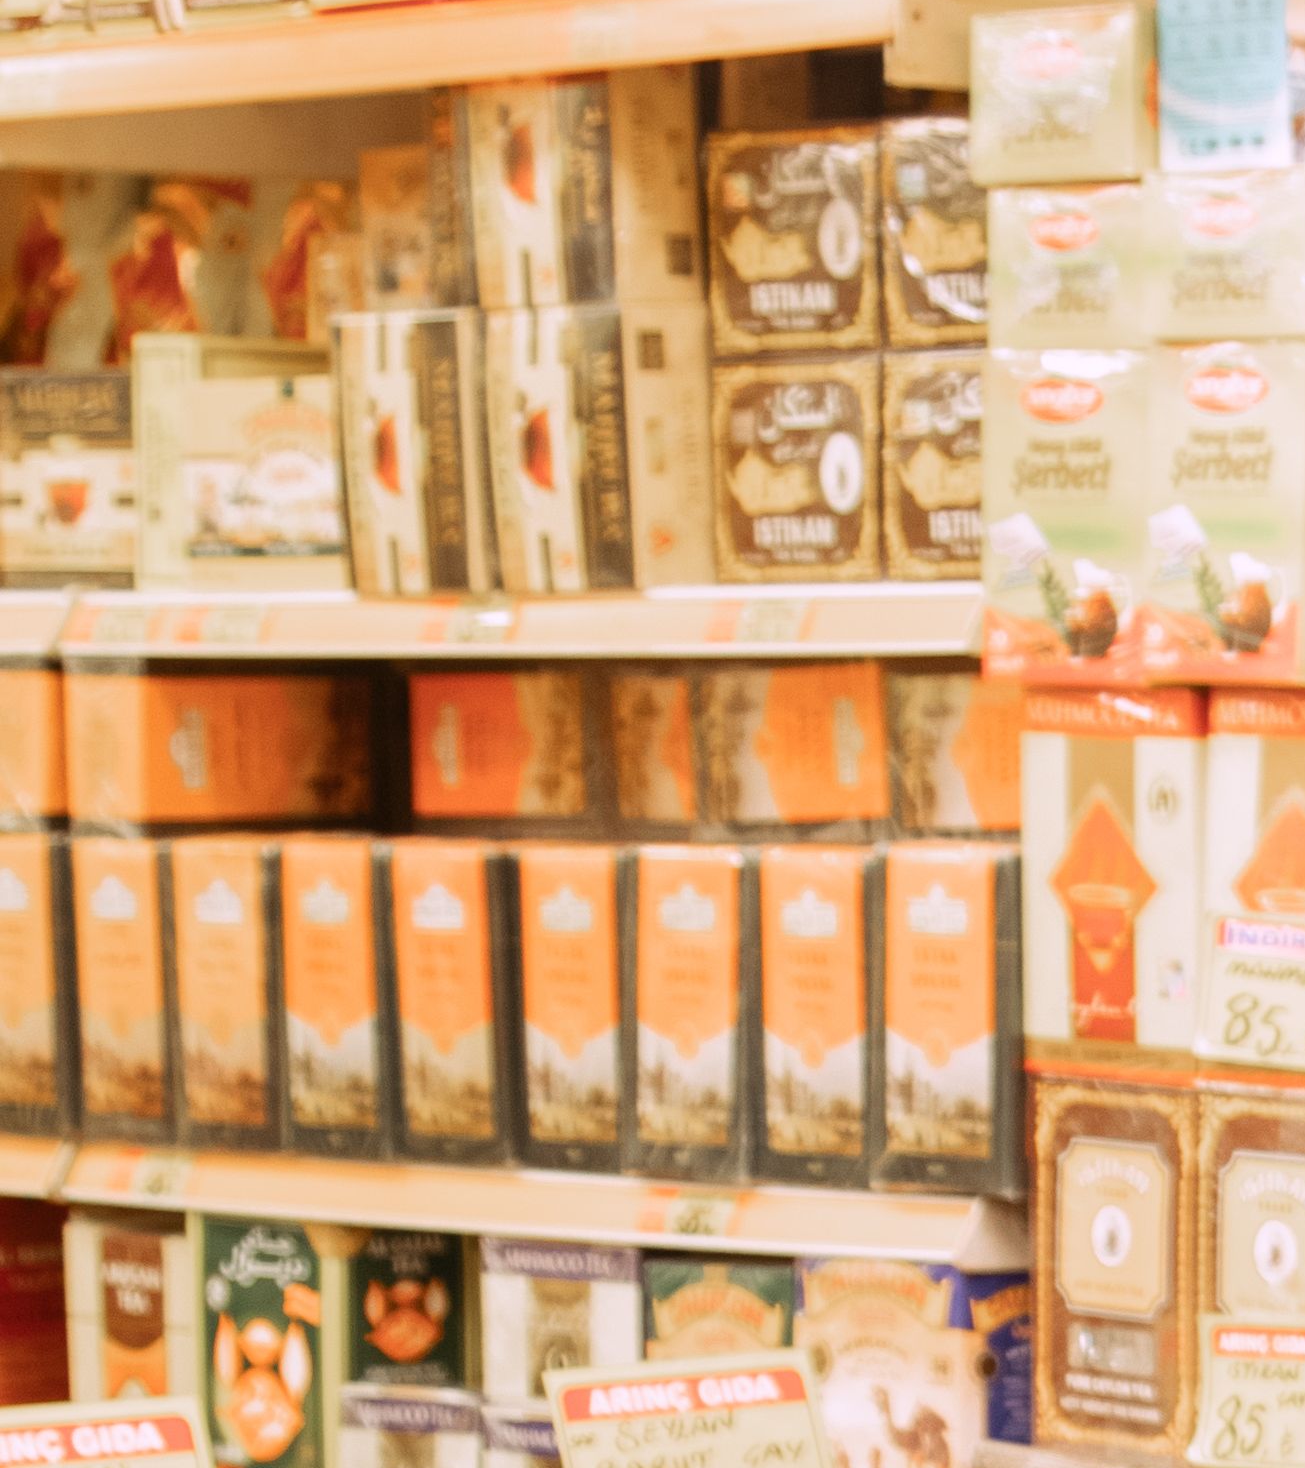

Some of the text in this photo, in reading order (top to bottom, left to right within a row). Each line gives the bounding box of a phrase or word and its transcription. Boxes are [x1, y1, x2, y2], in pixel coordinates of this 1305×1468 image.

[588, 1374, 780, 1417] ARINÇ GIDA
[71, 1421, 166, 1458] GIDA
